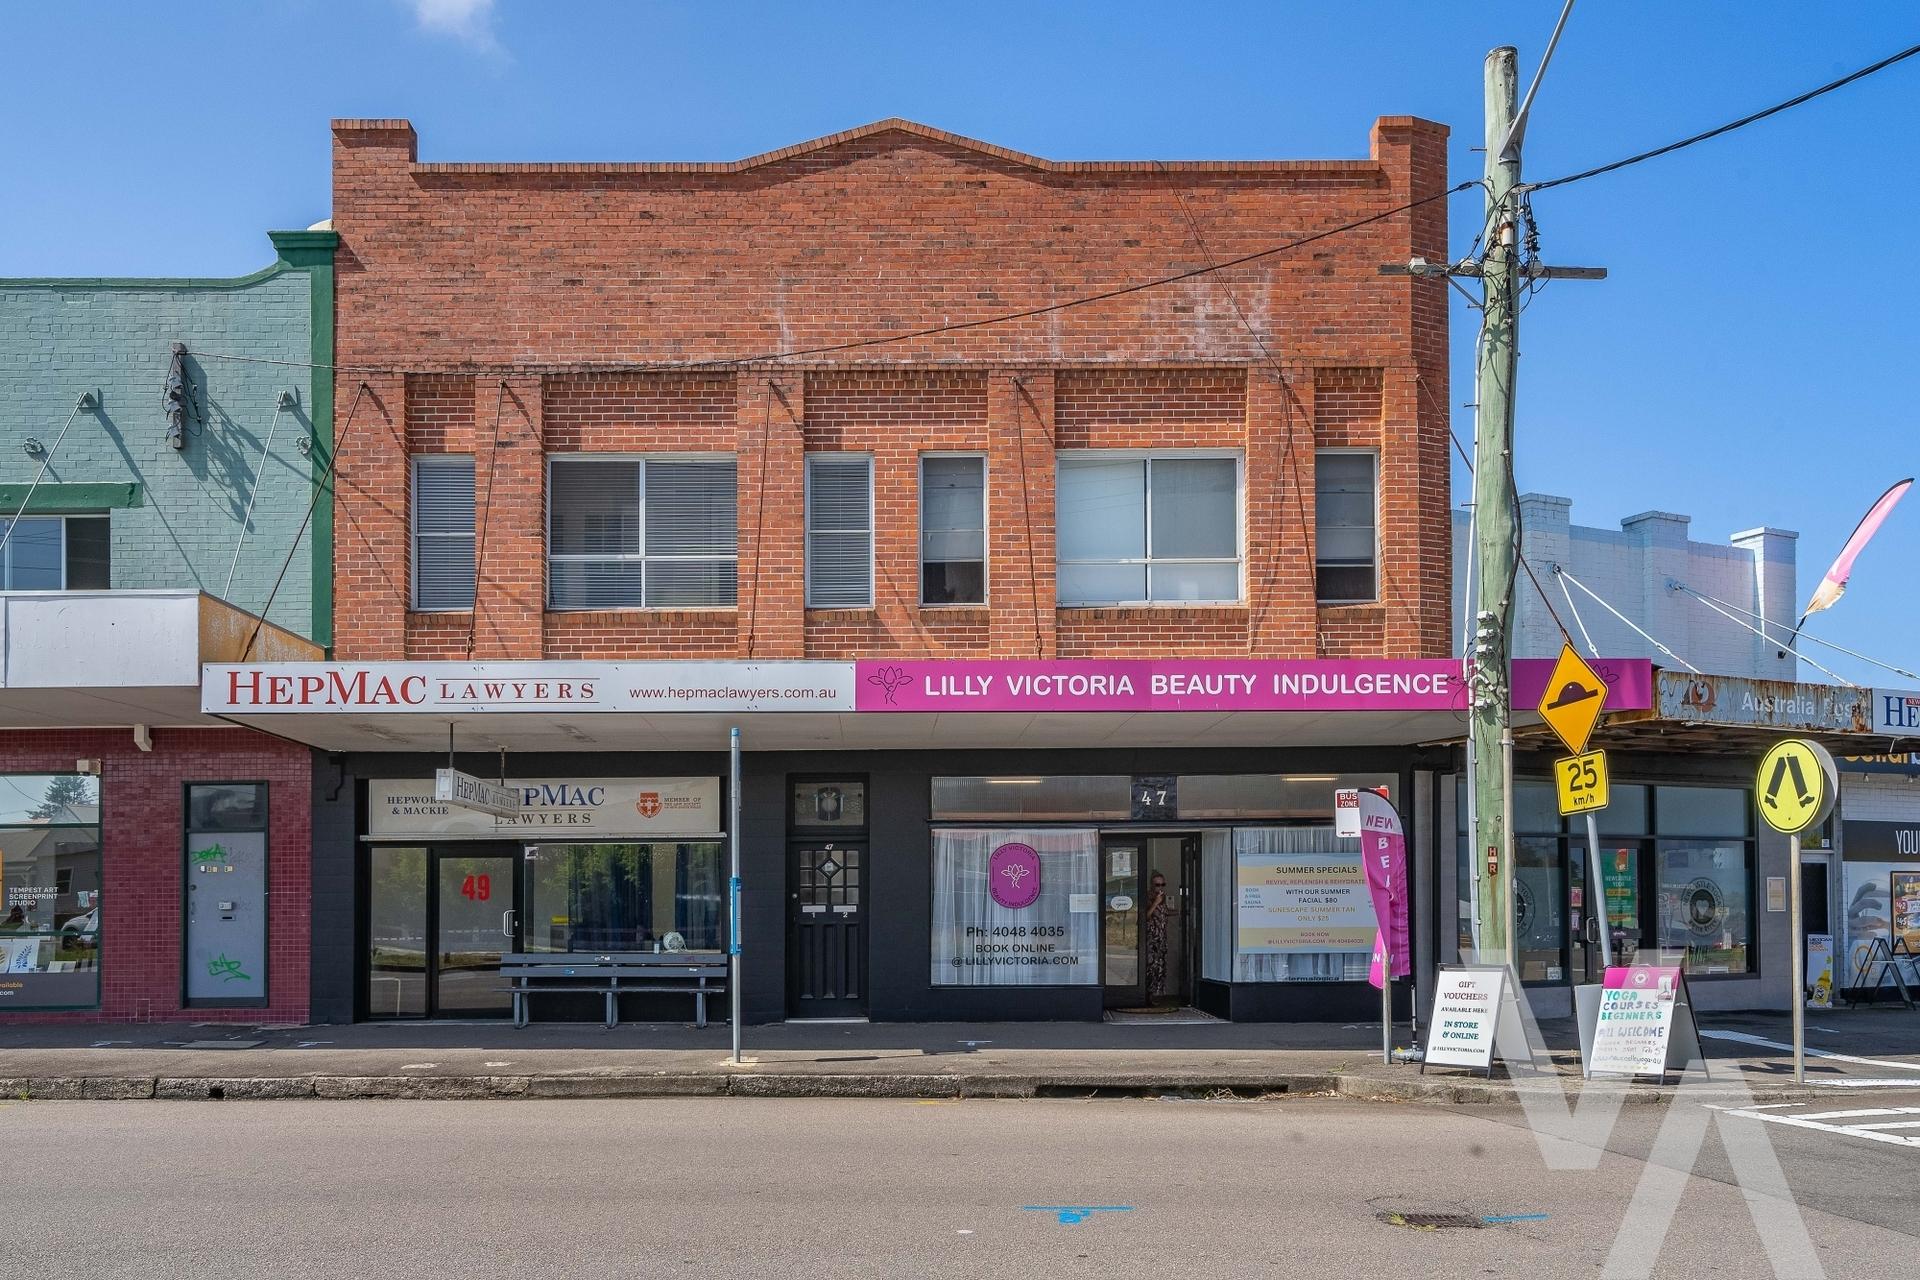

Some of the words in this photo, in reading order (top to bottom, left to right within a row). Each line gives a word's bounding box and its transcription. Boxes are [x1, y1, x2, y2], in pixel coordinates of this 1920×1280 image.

[925, 675, 993, 696] LILLY
[1007, 675, 1134, 696] VICTORIA
[1151, 674, 1257, 695] BEAUTY
[1273, 673, 1449, 695] INDULGENCE
[440, 683, 594, 699] LAWYERS
[630, 686, 836, 701] www.hepmaclawyers.com.au
[1742, 692, 1815, 715] Australia
[1568, 759, 1597, 792] 25
[1141, 791, 1167, 806] 47
[1573, 793, 1594, 806] km/h
[1341, 800, 1358, 808] ZONE
[392, 807, 400, 815] &
[403, 807, 449, 815] MACKIE
[494, 813, 592, 825] LAWYERS
[1316, 866, 1358, 874] SPECIALS
[462, 874, 491, 901] 49
[966, 926, 988, 937] Ph:
[992, 926, 1026, 937] 4048
[1030, 926, 1065, 937] 4035
[975, 944, 1009, 953] BOOK
[1012, 944, 1055, 953] ONLINE
[965, 956, 1079, 966] LILLYVICTORIA.COM
[1458, 981, 1477, 989] GIFT
[1443, 992, 1489, 1001] VOUCHERS
[1605, 990, 1638, 1001] YOGA
[1603, 1001, 1659, 1011] COURSES
[1601, 1011, 1662, 1021] BEGINNERS
[1453, 1021, 1479, 1029] STORE
[1442, 1031, 1450, 1039] &
[1450, 1032, 1479, 1040] ONLINE
[1617, 1026, 1664, 1038] WELCOME
